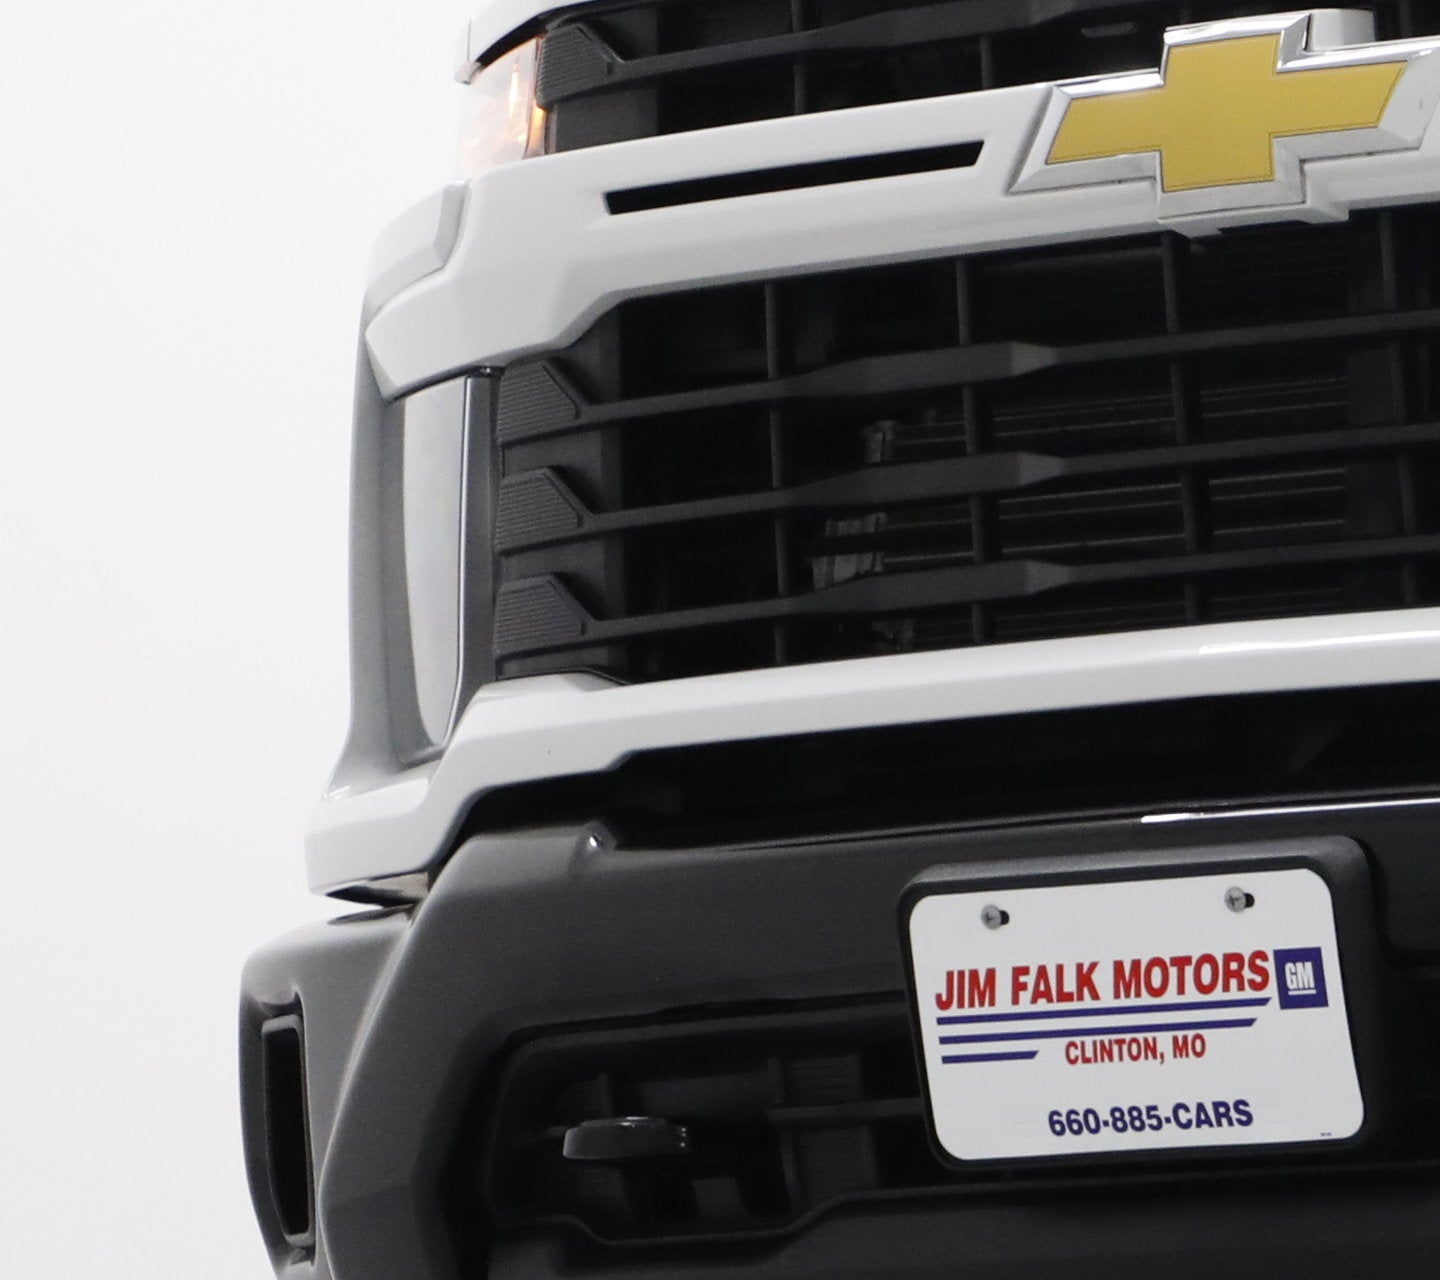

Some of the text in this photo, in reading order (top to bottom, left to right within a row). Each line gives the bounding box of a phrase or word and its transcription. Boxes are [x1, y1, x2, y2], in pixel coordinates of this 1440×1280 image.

[935, 950, 1271, 1010] JIM FALK MOTORS
[1284, 961, 1315, 990] GM
[1065, 1033, 1206, 1065] CLINTON, MO
[1048, 1099, 1254, 1136] 660-885-CARS
